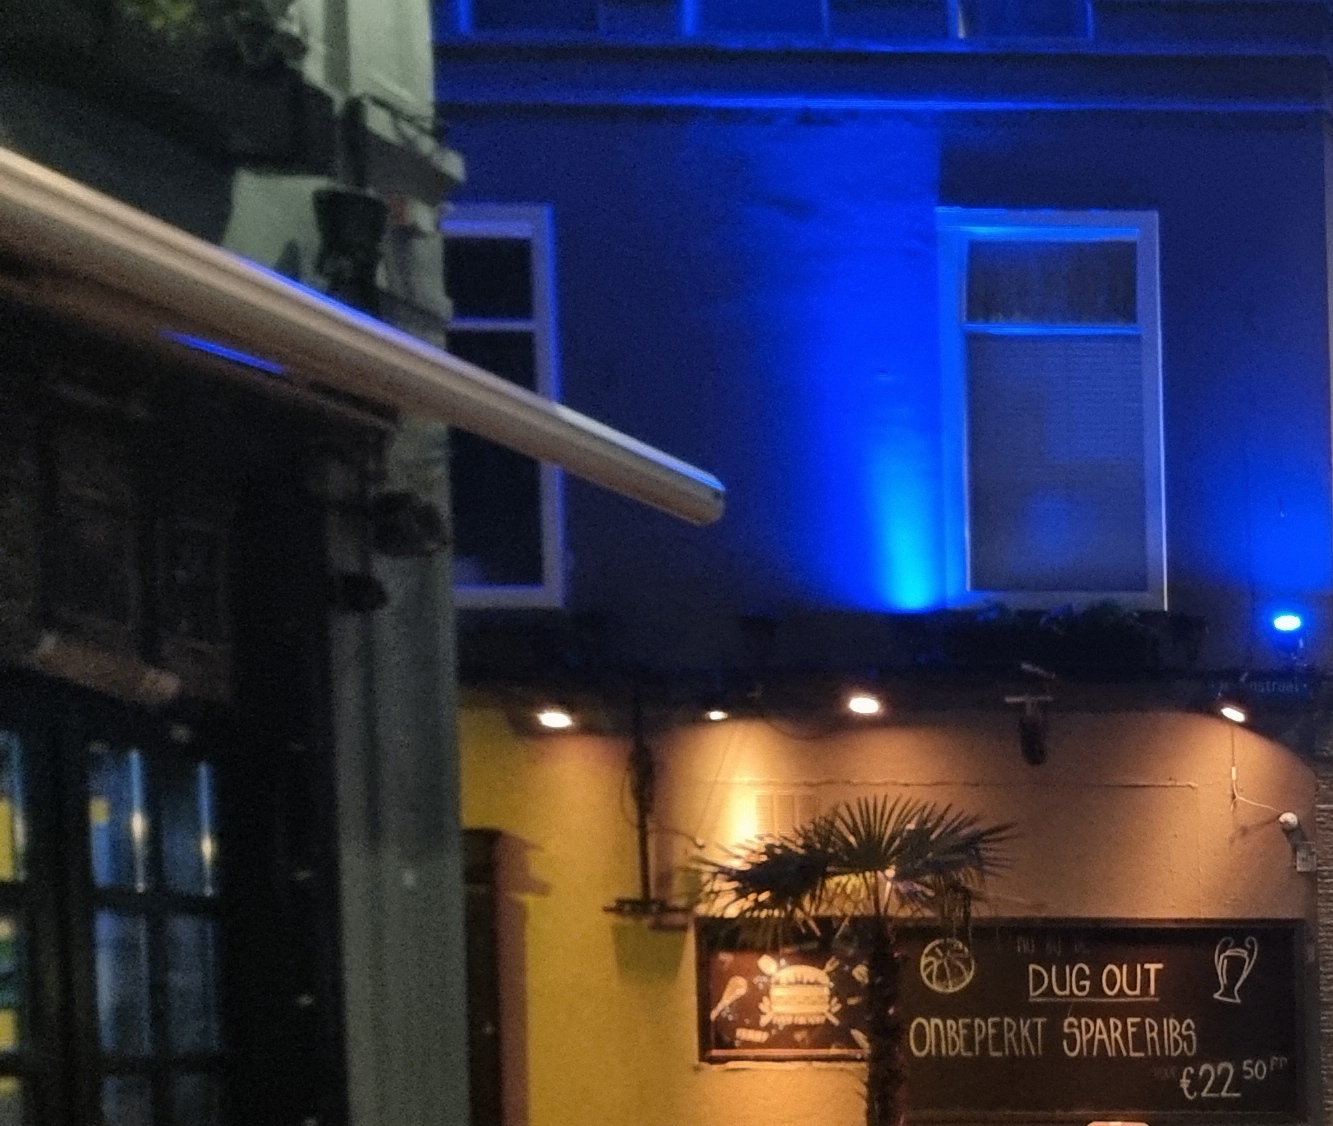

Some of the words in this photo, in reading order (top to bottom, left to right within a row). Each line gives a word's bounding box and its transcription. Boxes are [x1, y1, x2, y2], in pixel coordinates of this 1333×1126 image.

[1028, 963, 1091, 996] DUG
[1101, 963, 1164, 996] OUT
[1062, 1016, 1197, 1057] SPARERIBS
